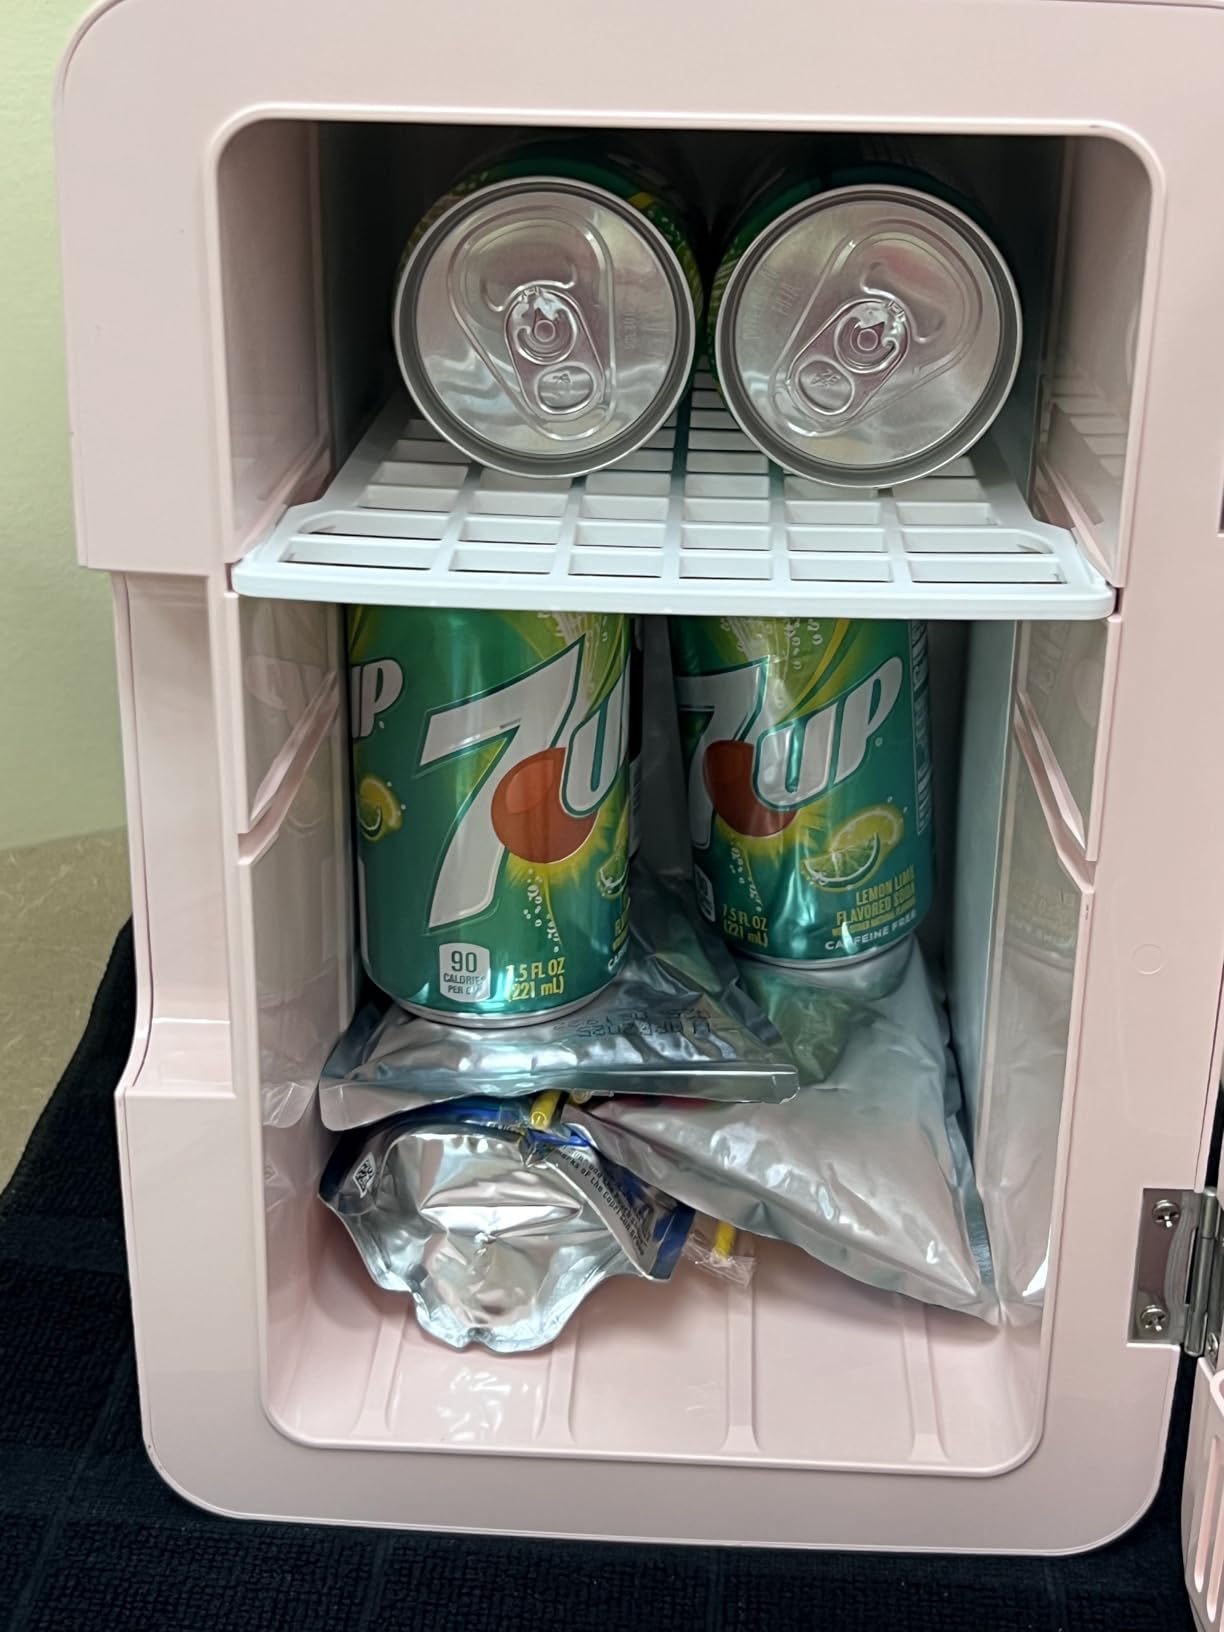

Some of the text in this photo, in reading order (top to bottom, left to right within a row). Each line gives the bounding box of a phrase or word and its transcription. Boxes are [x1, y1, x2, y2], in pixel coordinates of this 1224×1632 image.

[855, 879, 893, 906] LEMON
[752, 915, 768, 931] OZ
[451, 950, 478, 973] 90
[531, 961, 546, 980] FL
[547, 956, 566, 976] OZ
[447, 984, 464, 995] PER
[540, 975, 564, 996] mL)
[590, 1175, 604, 1193] the
[602, 1190, 622, 1215] Capri
